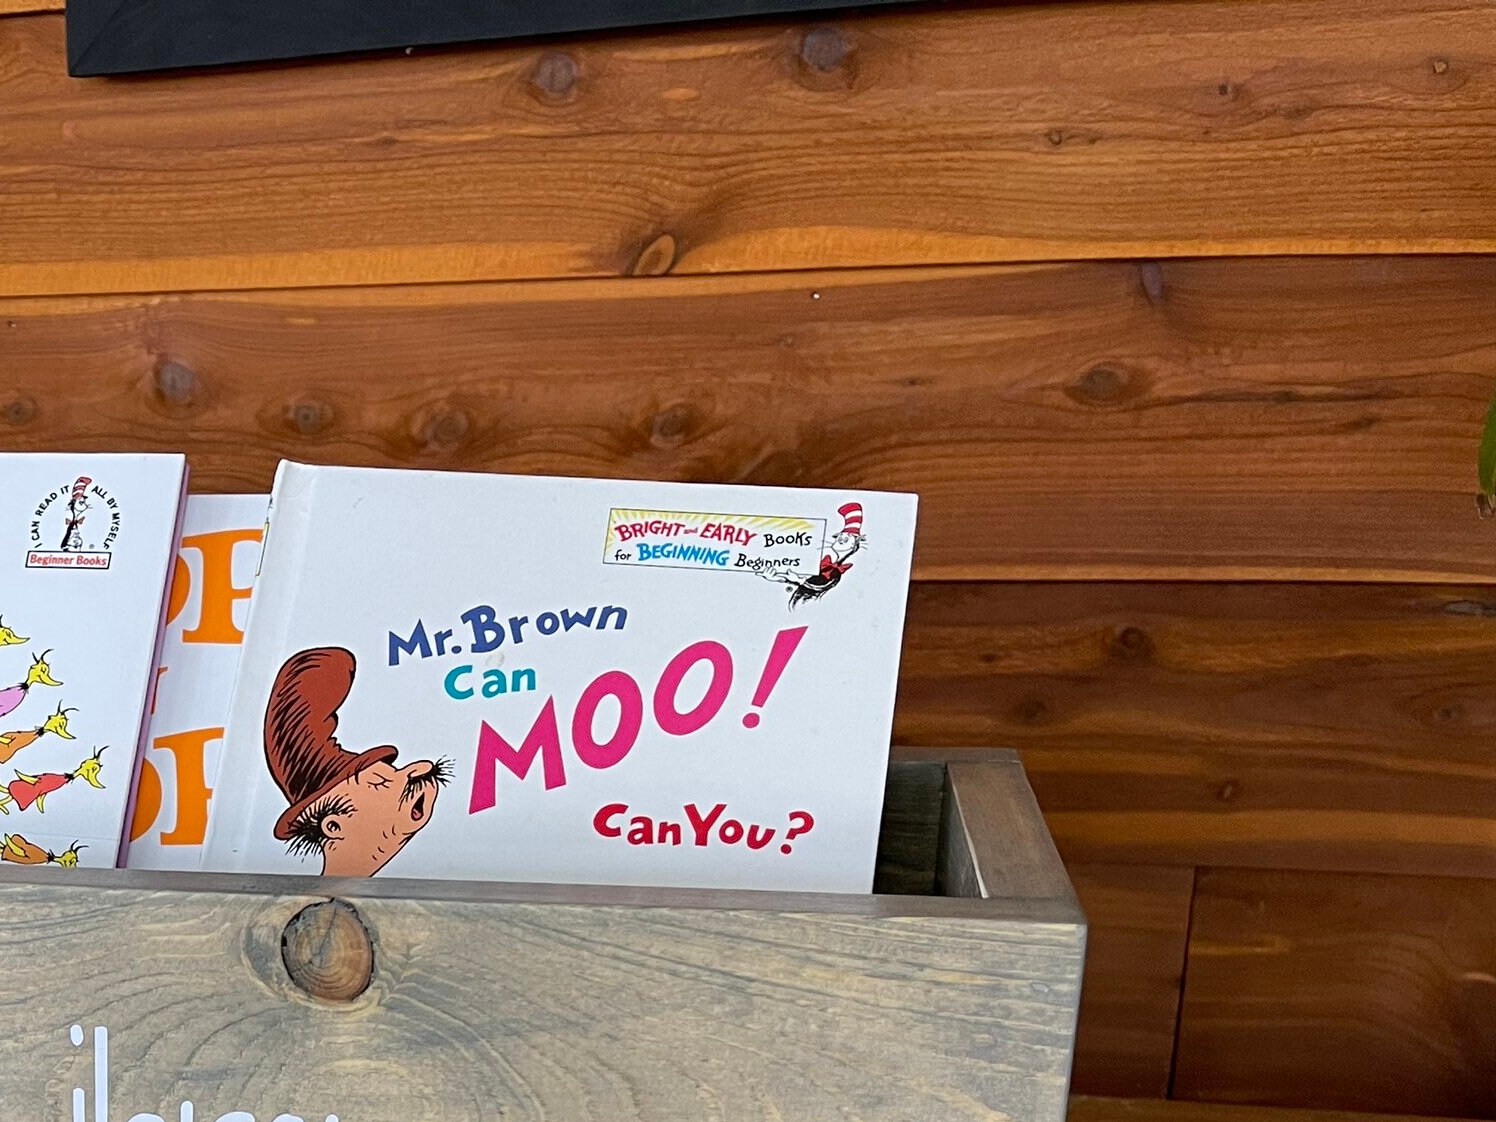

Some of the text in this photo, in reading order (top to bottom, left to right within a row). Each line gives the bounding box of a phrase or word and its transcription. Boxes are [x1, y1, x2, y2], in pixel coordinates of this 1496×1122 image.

[60, 485, 69, 495] IT
[91, 485, 108, 499] ALL
[35, 492, 58, 516] READ
[107, 498, 119, 510] BY
[31, 521, 40, 541] CAN
[103, 512, 121, 550] MYSELF
[614, 520, 686, 542] BRIGHT
[699, 522, 758, 546] EARLY
[29, 554, 107, 566] Beginner Books
[614, 542, 801, 570] for BEGINNING Beginners
[460, 604, 628, 654] Brown
[443, 664, 536, 700] Can
[468, 625, 809, 815] MOO!
